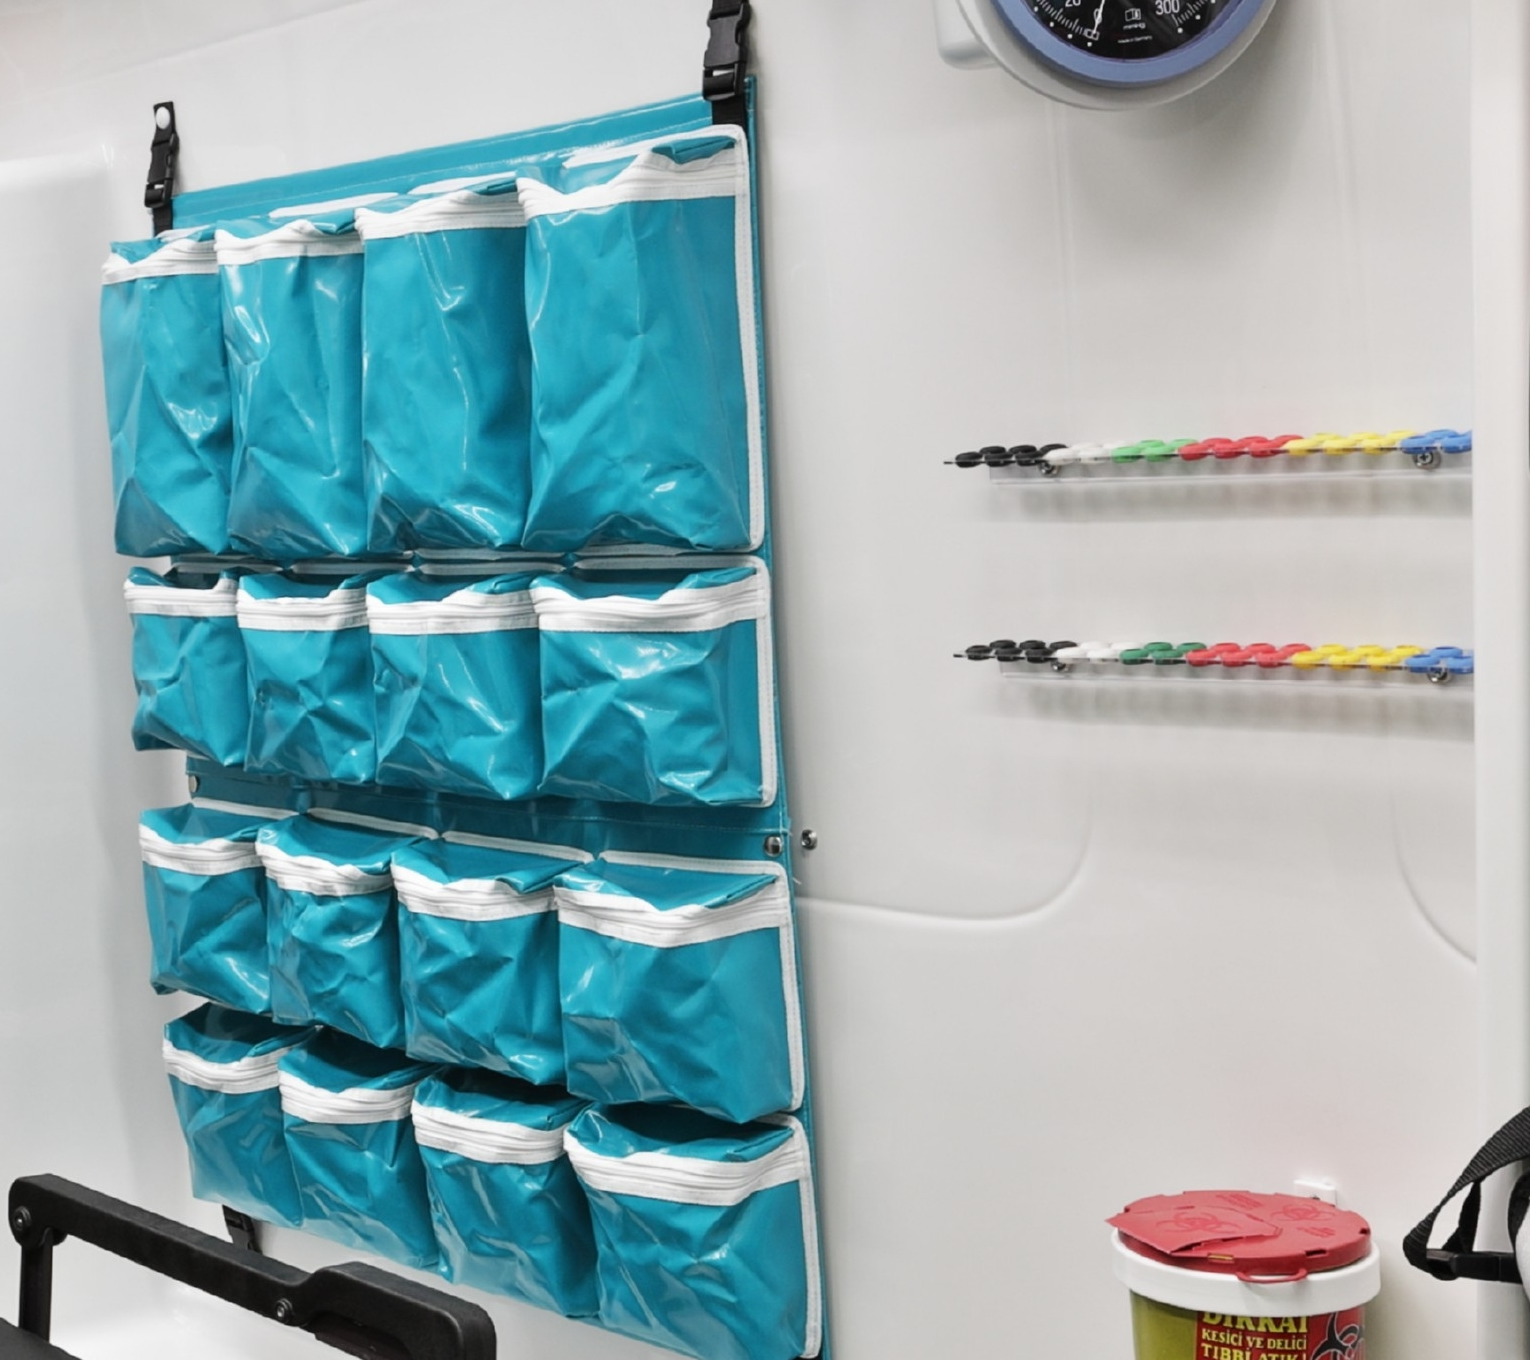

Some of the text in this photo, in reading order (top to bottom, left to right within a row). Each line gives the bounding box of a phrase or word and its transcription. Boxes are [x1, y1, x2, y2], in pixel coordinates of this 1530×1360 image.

[1201, 1328, 1307, 1350] KESİCİ VE DELİCİ
